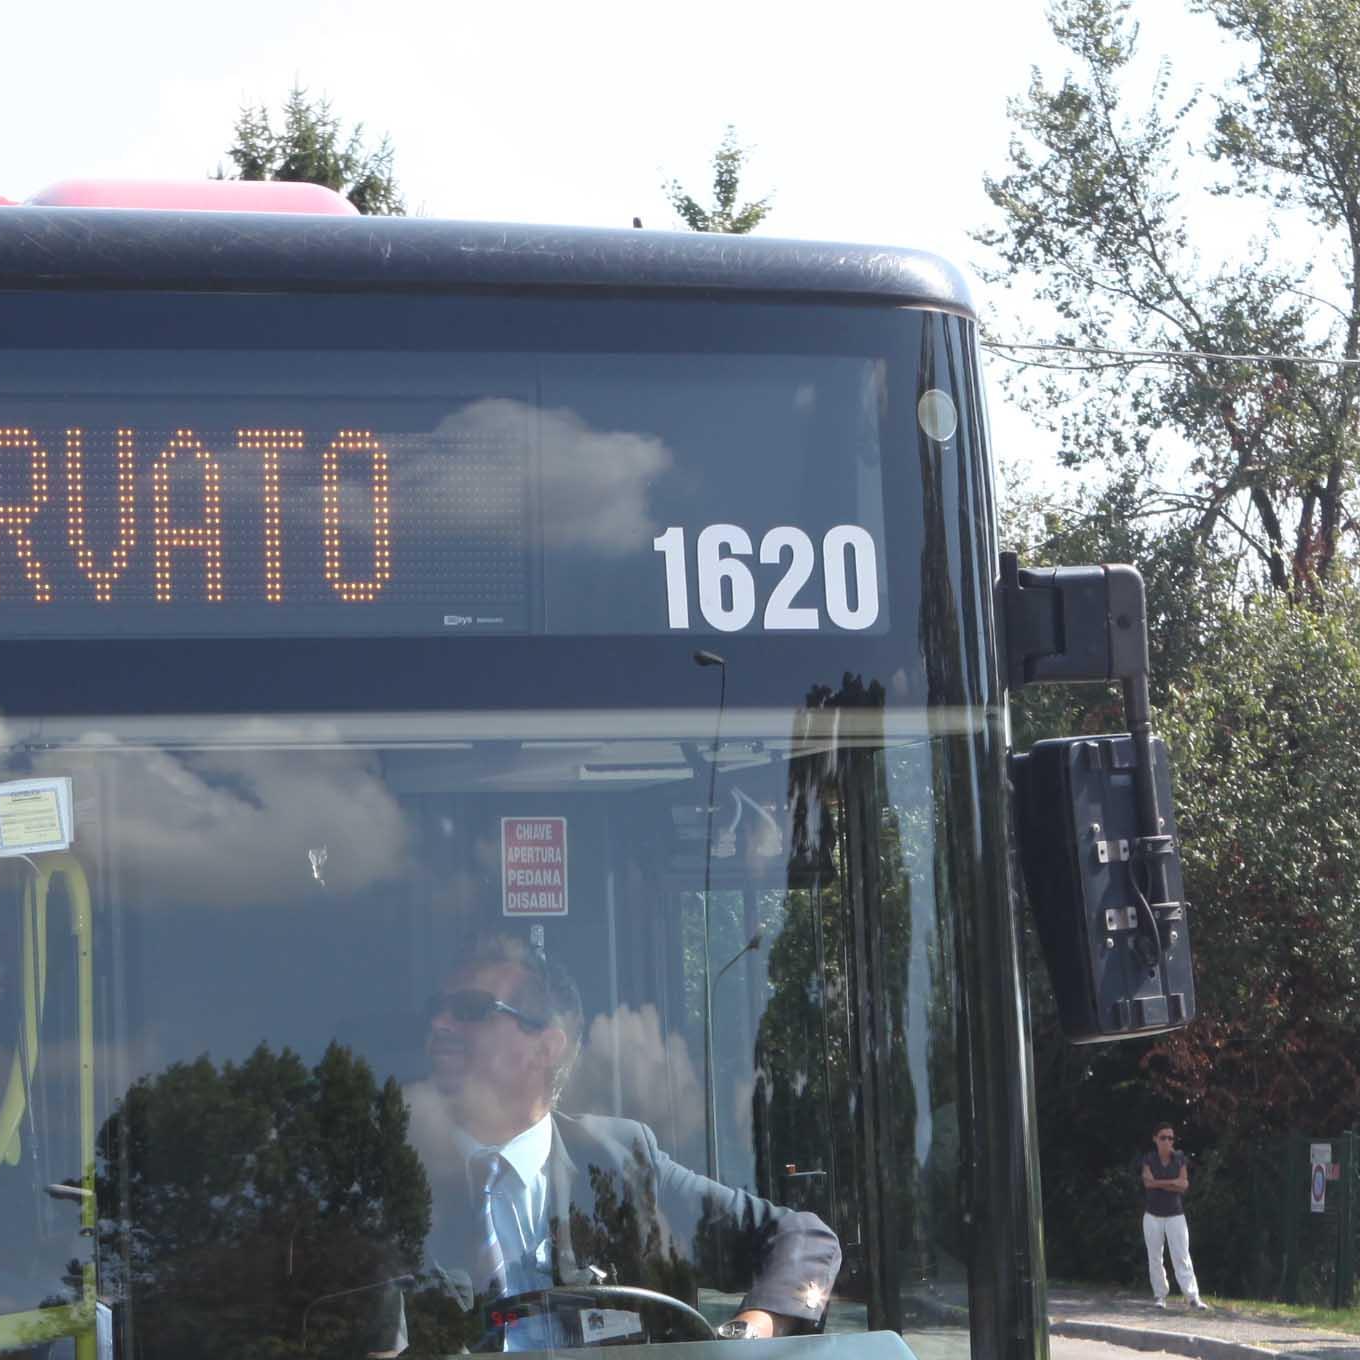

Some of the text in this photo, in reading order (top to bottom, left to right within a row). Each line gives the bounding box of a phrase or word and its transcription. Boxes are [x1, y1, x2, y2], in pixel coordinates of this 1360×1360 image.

[652, 523, 880, 632] 1620
[516, 824, 553, 840] CHIAVE
[507, 847, 561, 864] APERTURA
[508, 870, 561, 887] PEDANA
[508, 892, 563, 910] DISABILI
